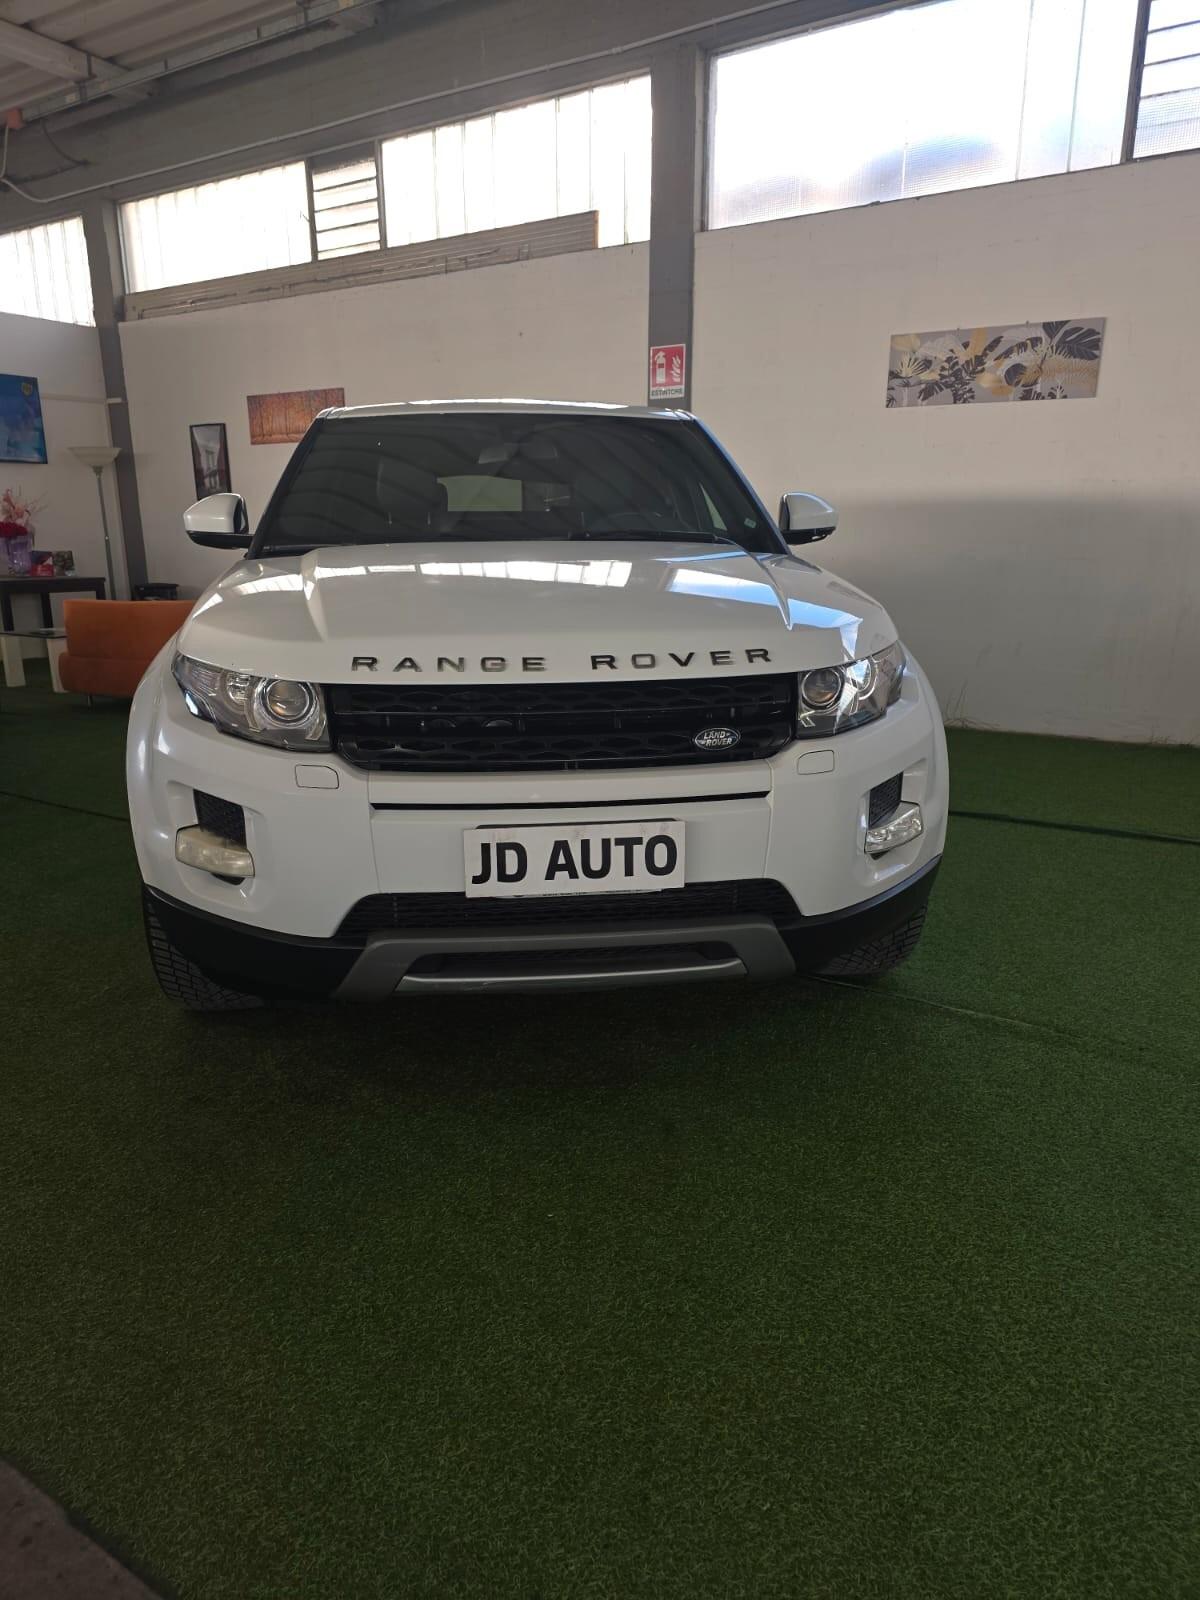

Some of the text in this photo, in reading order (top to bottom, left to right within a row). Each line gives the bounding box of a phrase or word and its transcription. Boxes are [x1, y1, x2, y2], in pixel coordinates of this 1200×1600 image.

[352, 648, 772, 673] RANGE ROVER
[704, 731, 726, 740] LAND
[705, 738, 733, 747] ROVER
[471, 834, 678, 885] JD AUTO
